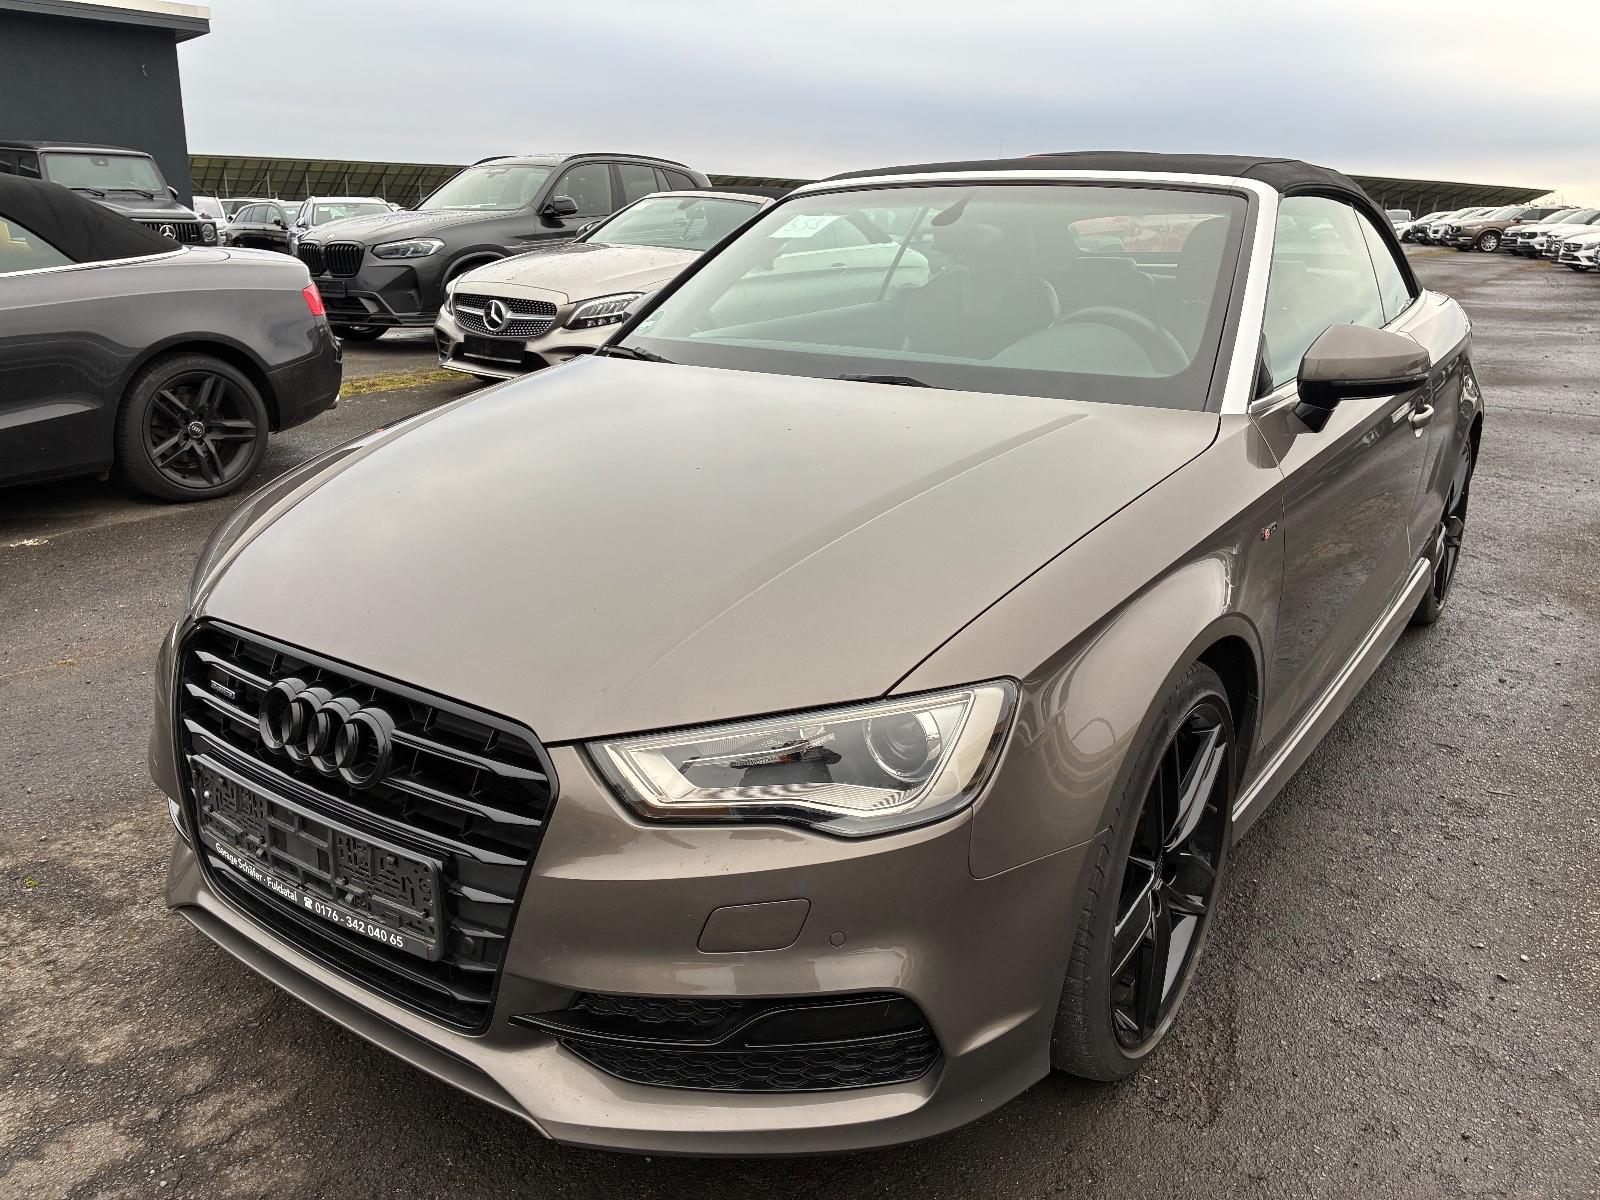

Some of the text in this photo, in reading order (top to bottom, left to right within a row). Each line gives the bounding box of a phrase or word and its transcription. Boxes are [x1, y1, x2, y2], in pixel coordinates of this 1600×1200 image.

[215, 842, 238, 865] Garage
[237, 858, 262, 881] Schäfer
[266, 876, 298, 902] Fuldatal
[315, 902, 338, 922] 0176
[345, 916, 365, 932] 342
[367, 925, 387, 941] 040
[389, 934, 403, 948] 65
